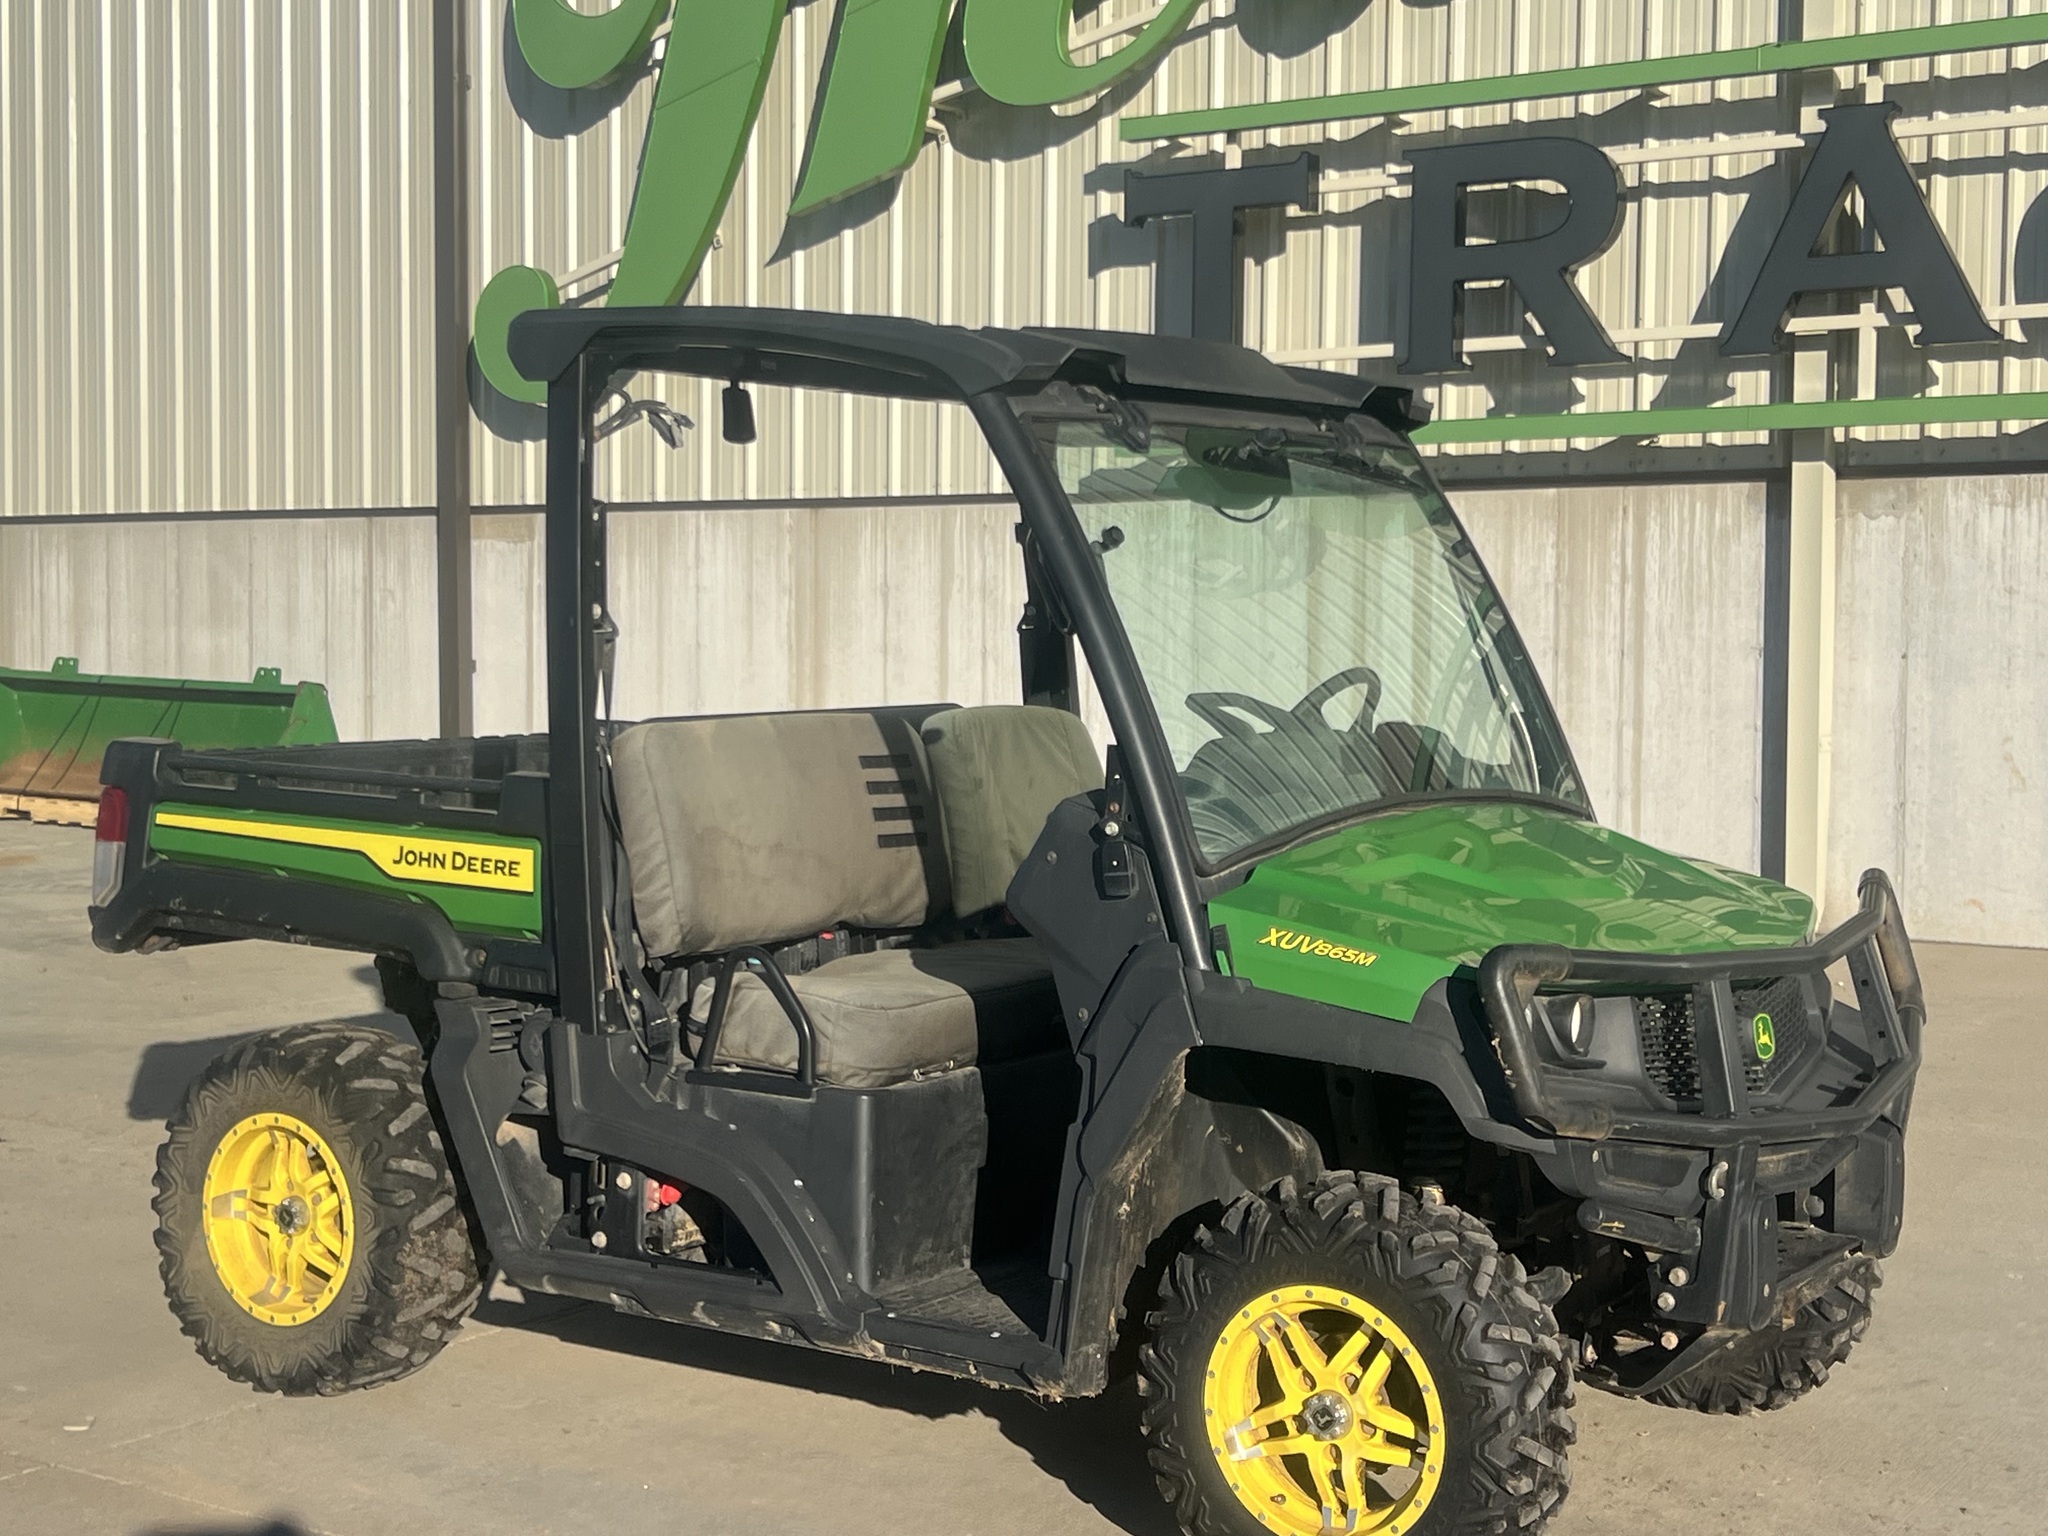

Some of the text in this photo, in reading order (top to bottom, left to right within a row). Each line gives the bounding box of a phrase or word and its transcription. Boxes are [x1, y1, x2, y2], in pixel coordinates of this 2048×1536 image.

[393, 845, 520, 877] JOHN DEERE
[1258, 926, 1378, 967] XUV865M
